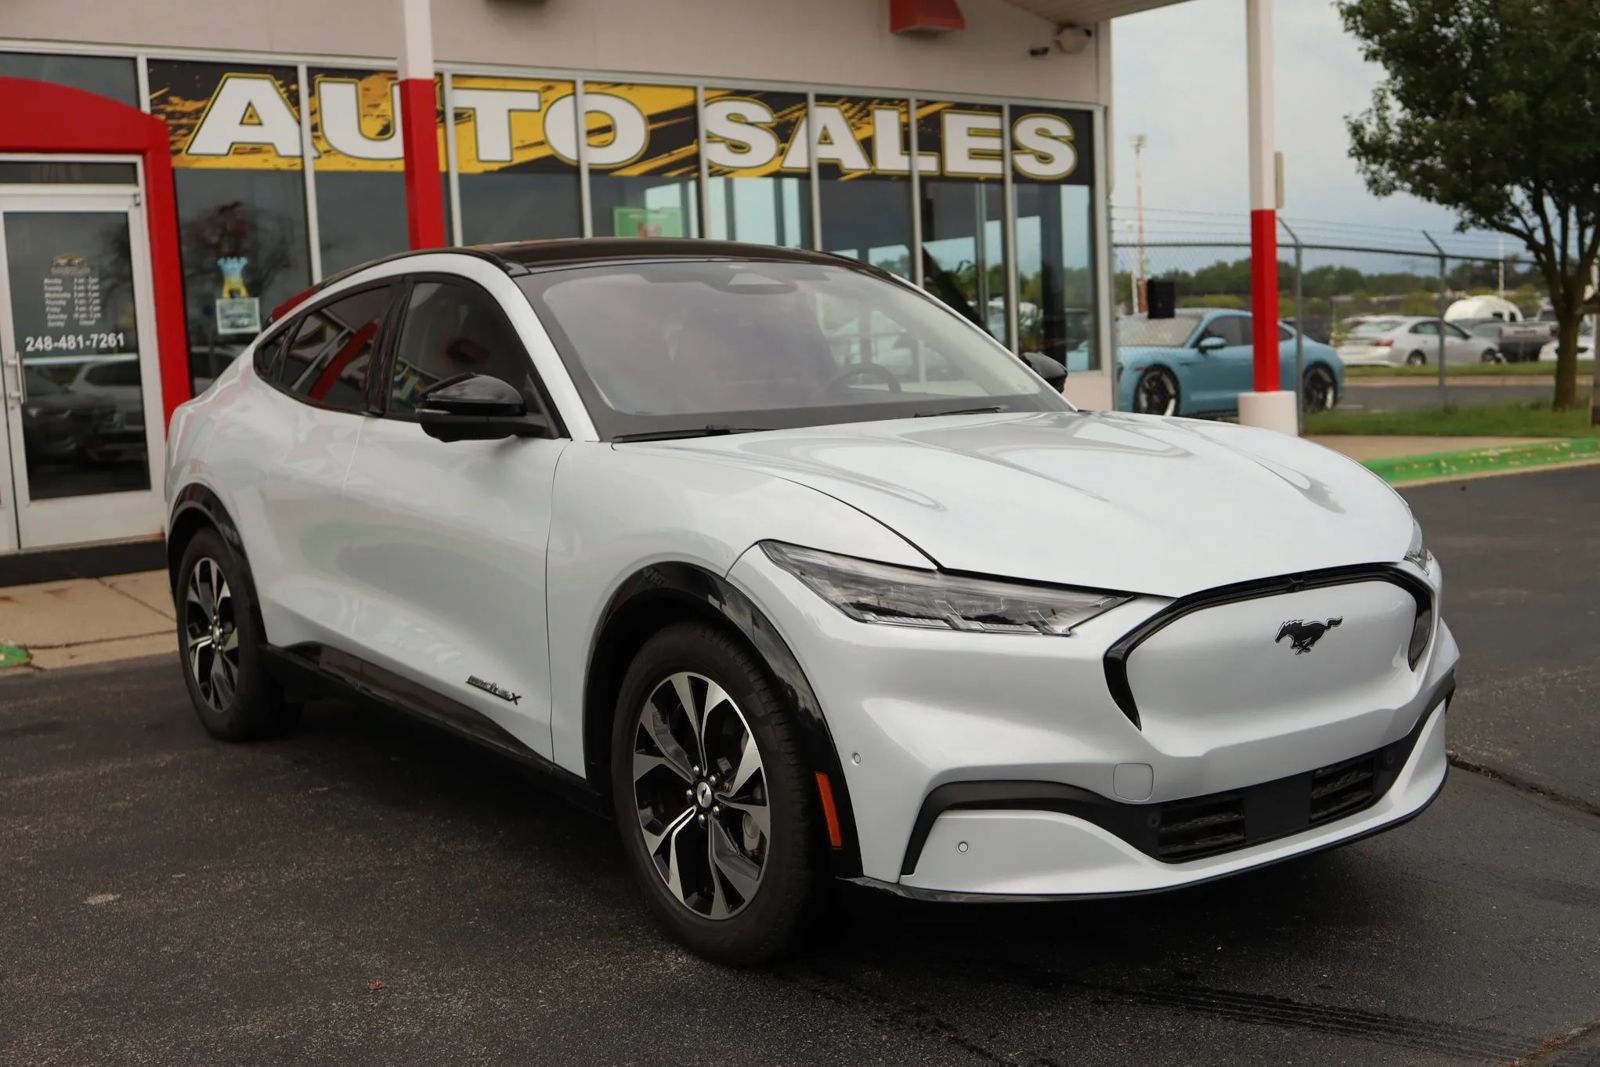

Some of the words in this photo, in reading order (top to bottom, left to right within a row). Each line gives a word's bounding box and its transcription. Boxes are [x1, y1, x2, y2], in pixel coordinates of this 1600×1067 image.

[185, 71, 651, 168] AUTO
[703, 95, 1078, 181] SALES
[25, 333, 125, 352] 248-481-7261
